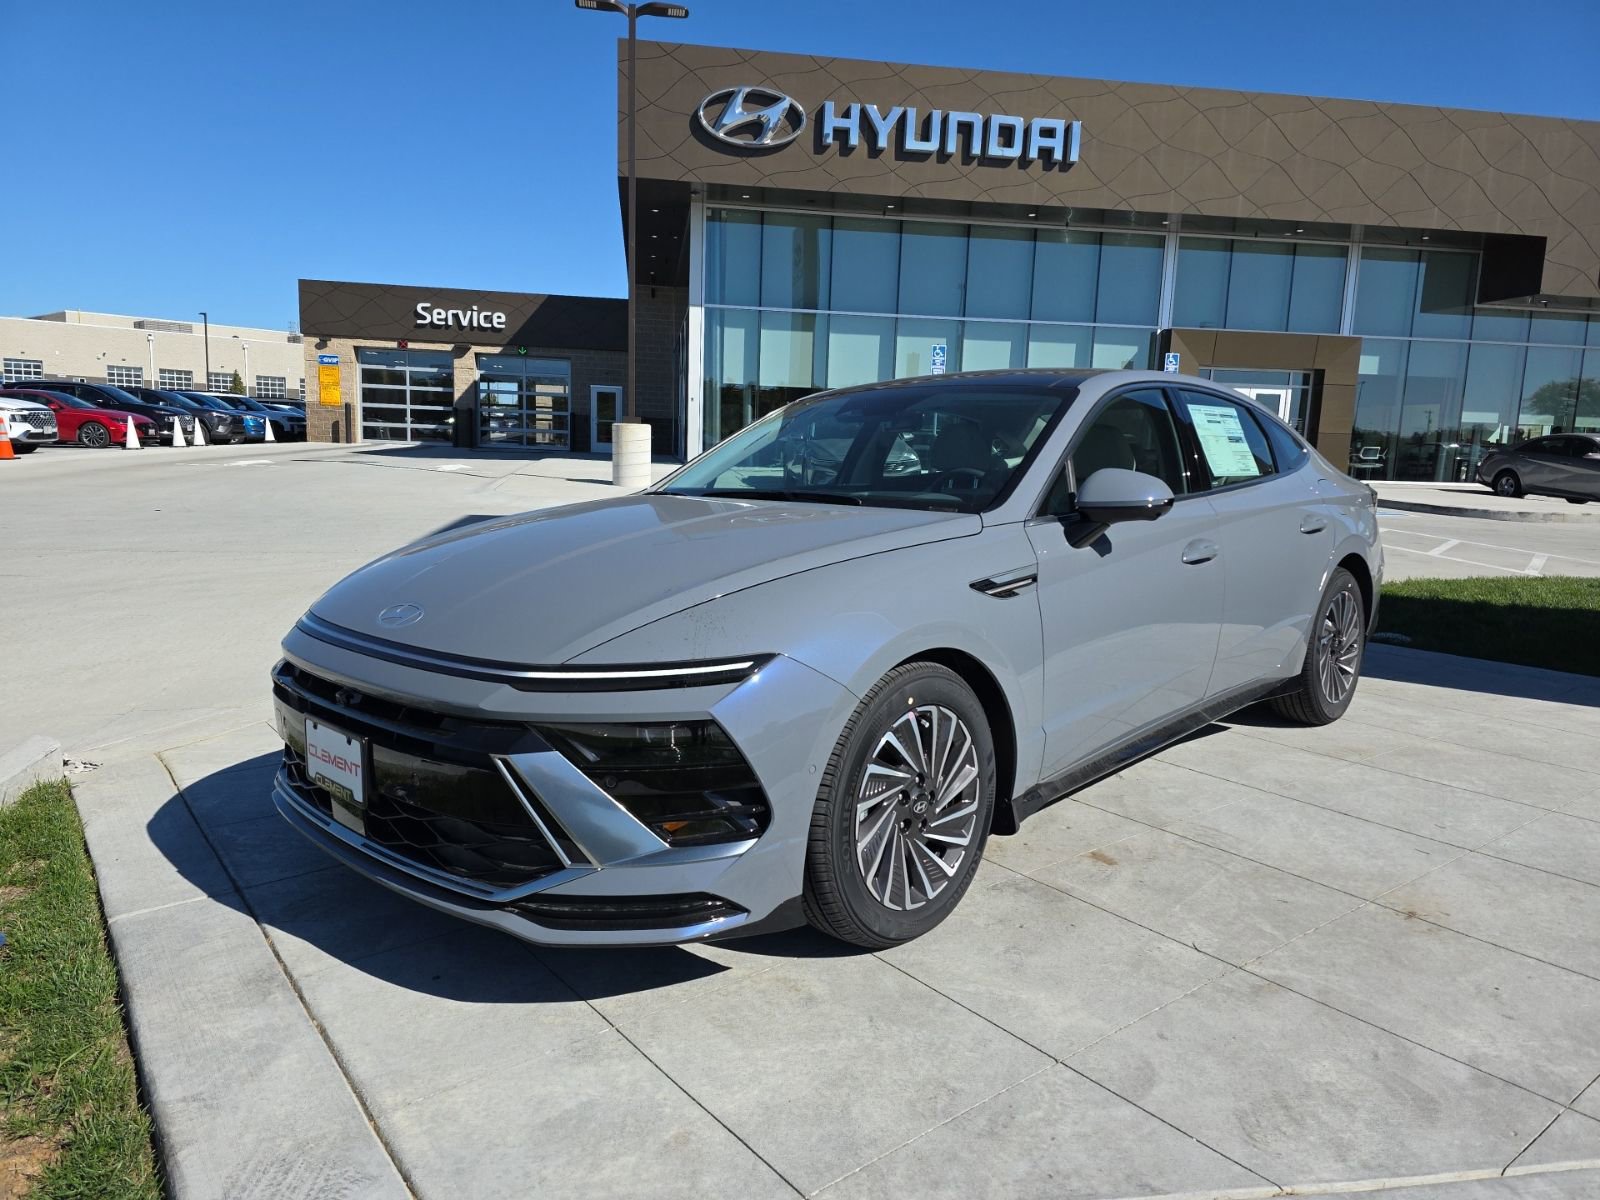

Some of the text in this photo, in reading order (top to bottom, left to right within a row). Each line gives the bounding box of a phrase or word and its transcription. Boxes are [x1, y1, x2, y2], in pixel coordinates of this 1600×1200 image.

[822, 100, 1082, 164] HYUNDAI
[416, 302, 506, 328] Service
[309, 743, 360, 776] CLEMENT
[316, 774, 352, 800] CLEMENT
[840, 795, 853, 874] SOLUS
